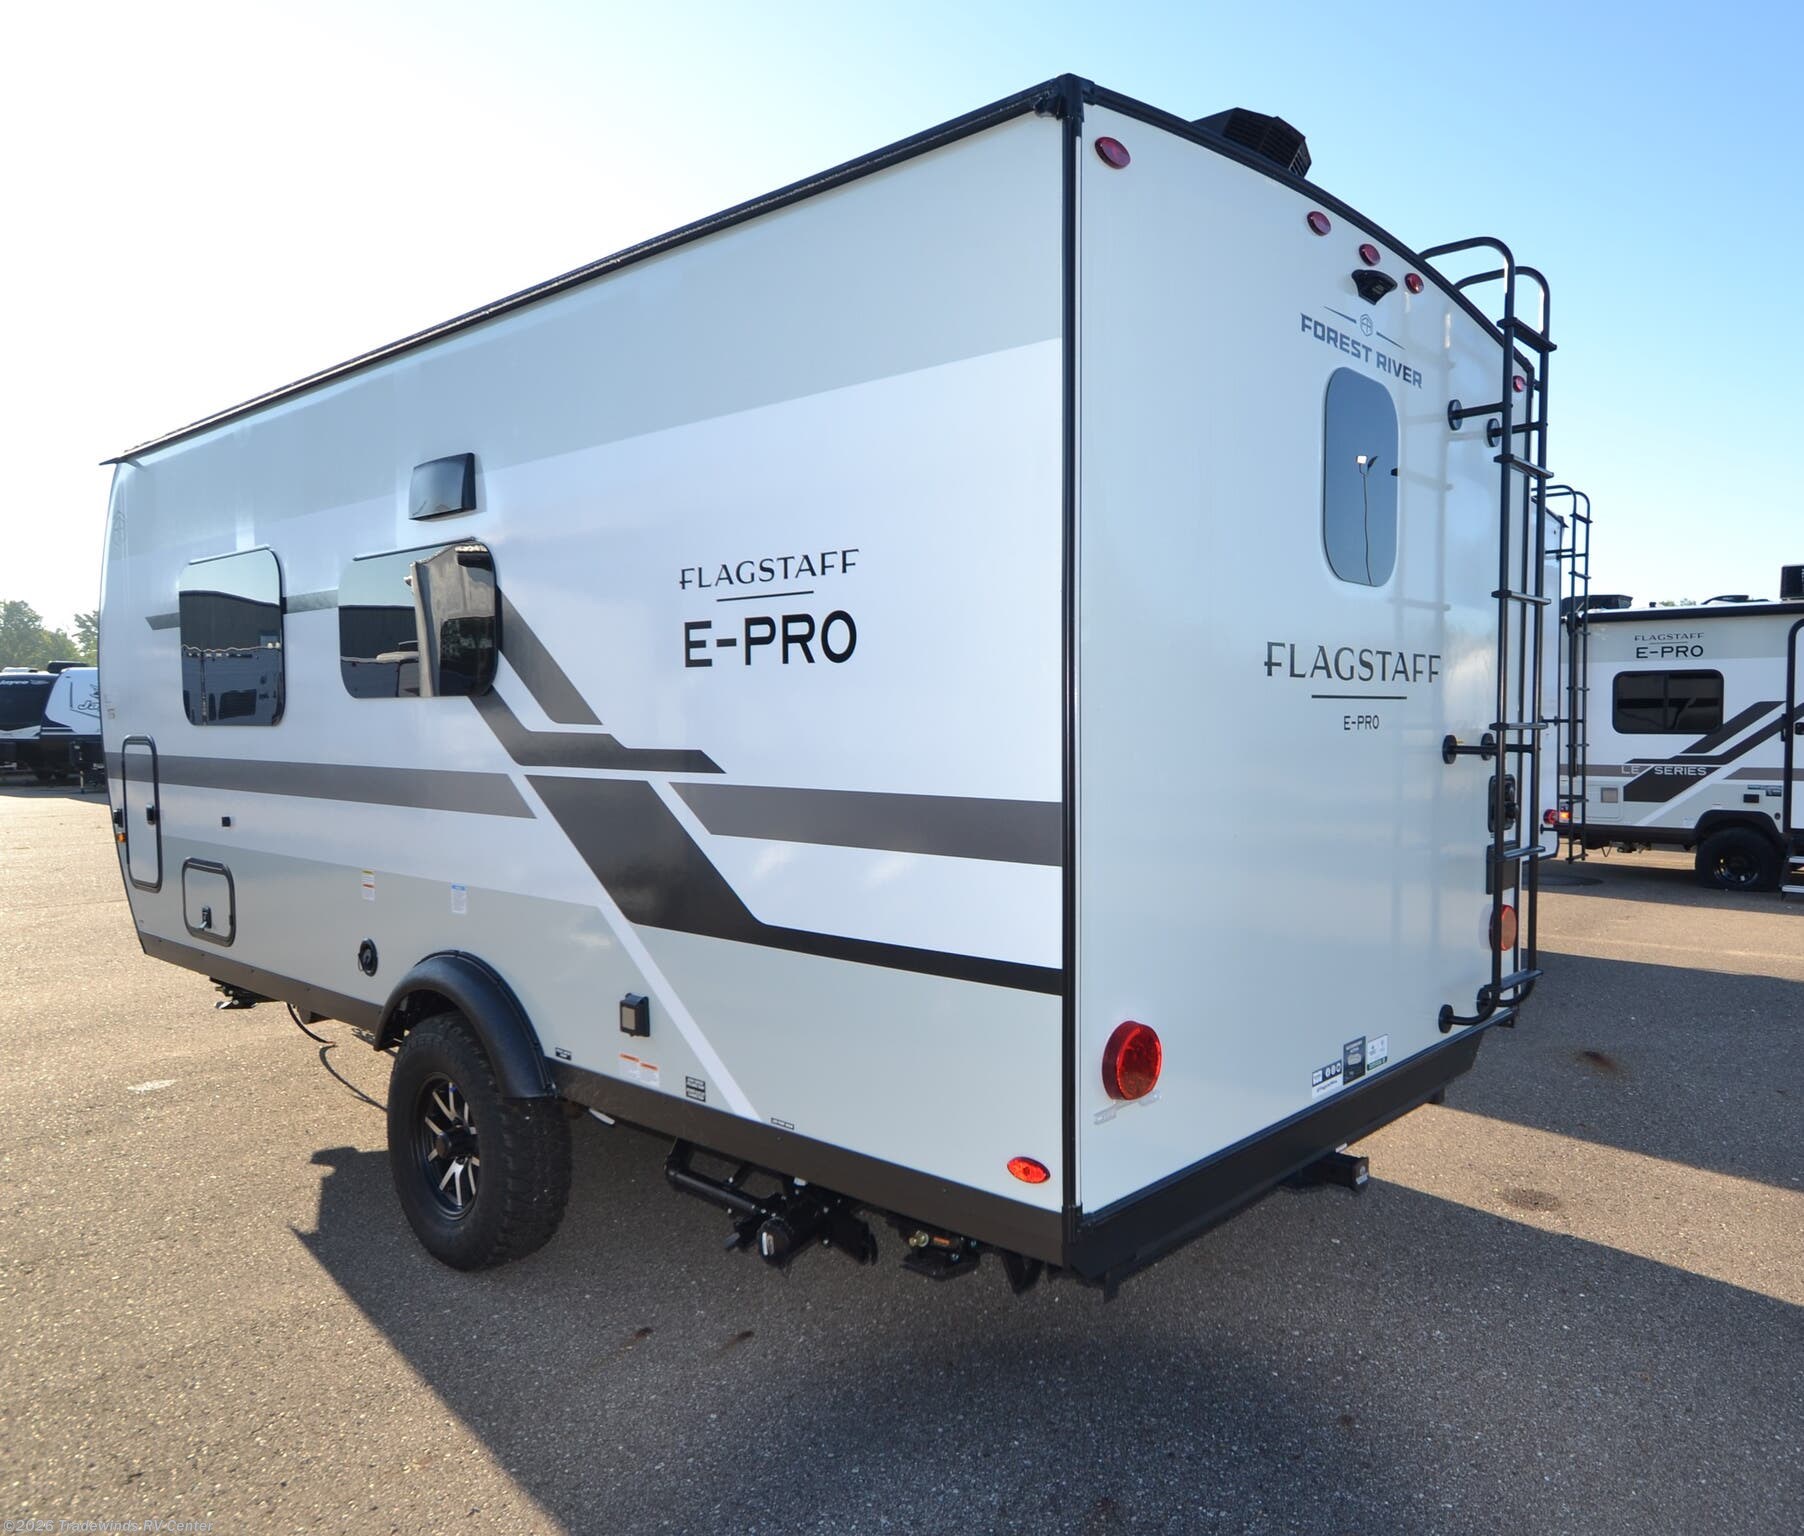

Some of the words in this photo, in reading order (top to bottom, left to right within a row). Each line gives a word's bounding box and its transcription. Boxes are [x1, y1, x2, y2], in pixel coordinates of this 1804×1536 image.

[1300, 313, 1373, 363] FOREST
[1376, 351, 1422, 389] RIVER
[679, 548, 860, 590] FLAGSTAFF
[684, 610, 857, 668] E-PRO
[1634, 632, 1705, 641] FLAGSTAFF
[1264, 641, 1441, 683] FLAGSTAFF
[1636, 645, 1704, 659] E-PRO
[1343, 714, 1380, 731] E-PRO
[1621, 764, 1640, 775] LE
[1654, 766, 1707, 776] SERIES
